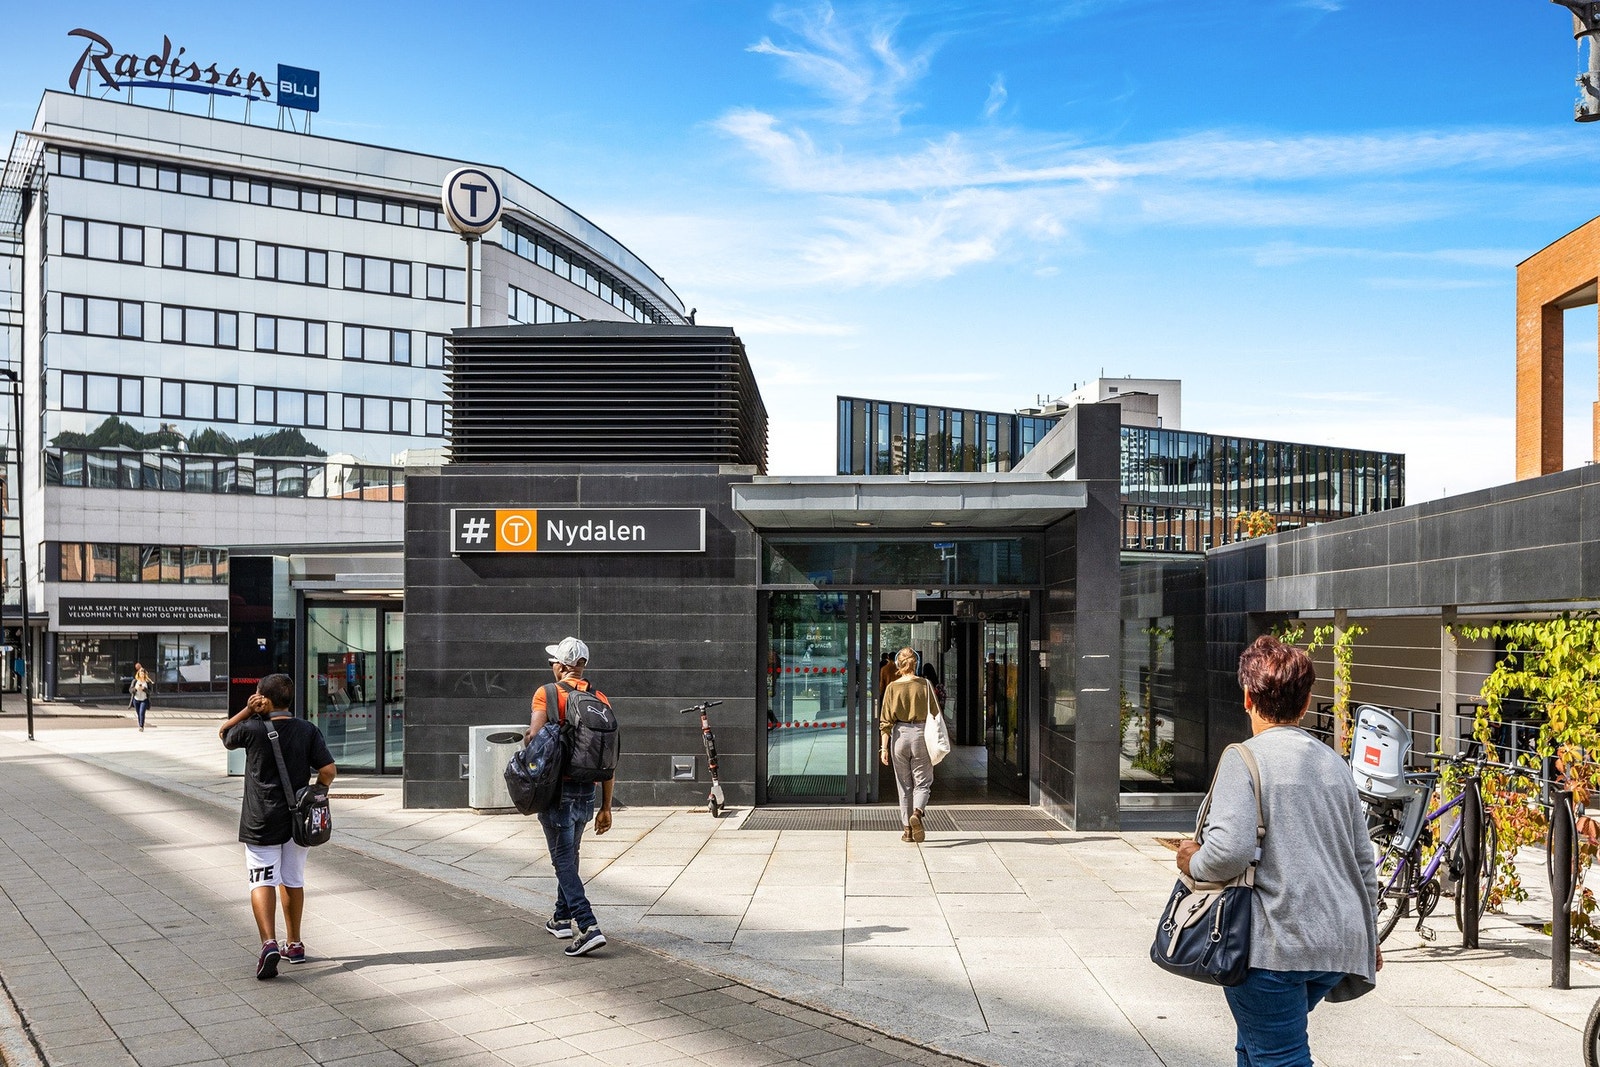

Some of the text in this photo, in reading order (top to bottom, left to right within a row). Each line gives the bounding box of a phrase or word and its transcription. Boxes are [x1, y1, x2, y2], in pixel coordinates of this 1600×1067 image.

[68, 28, 317, 98] Radisson BLU
[460, 183, 487, 217] T
[547, 519, 646, 546] Nydalen
